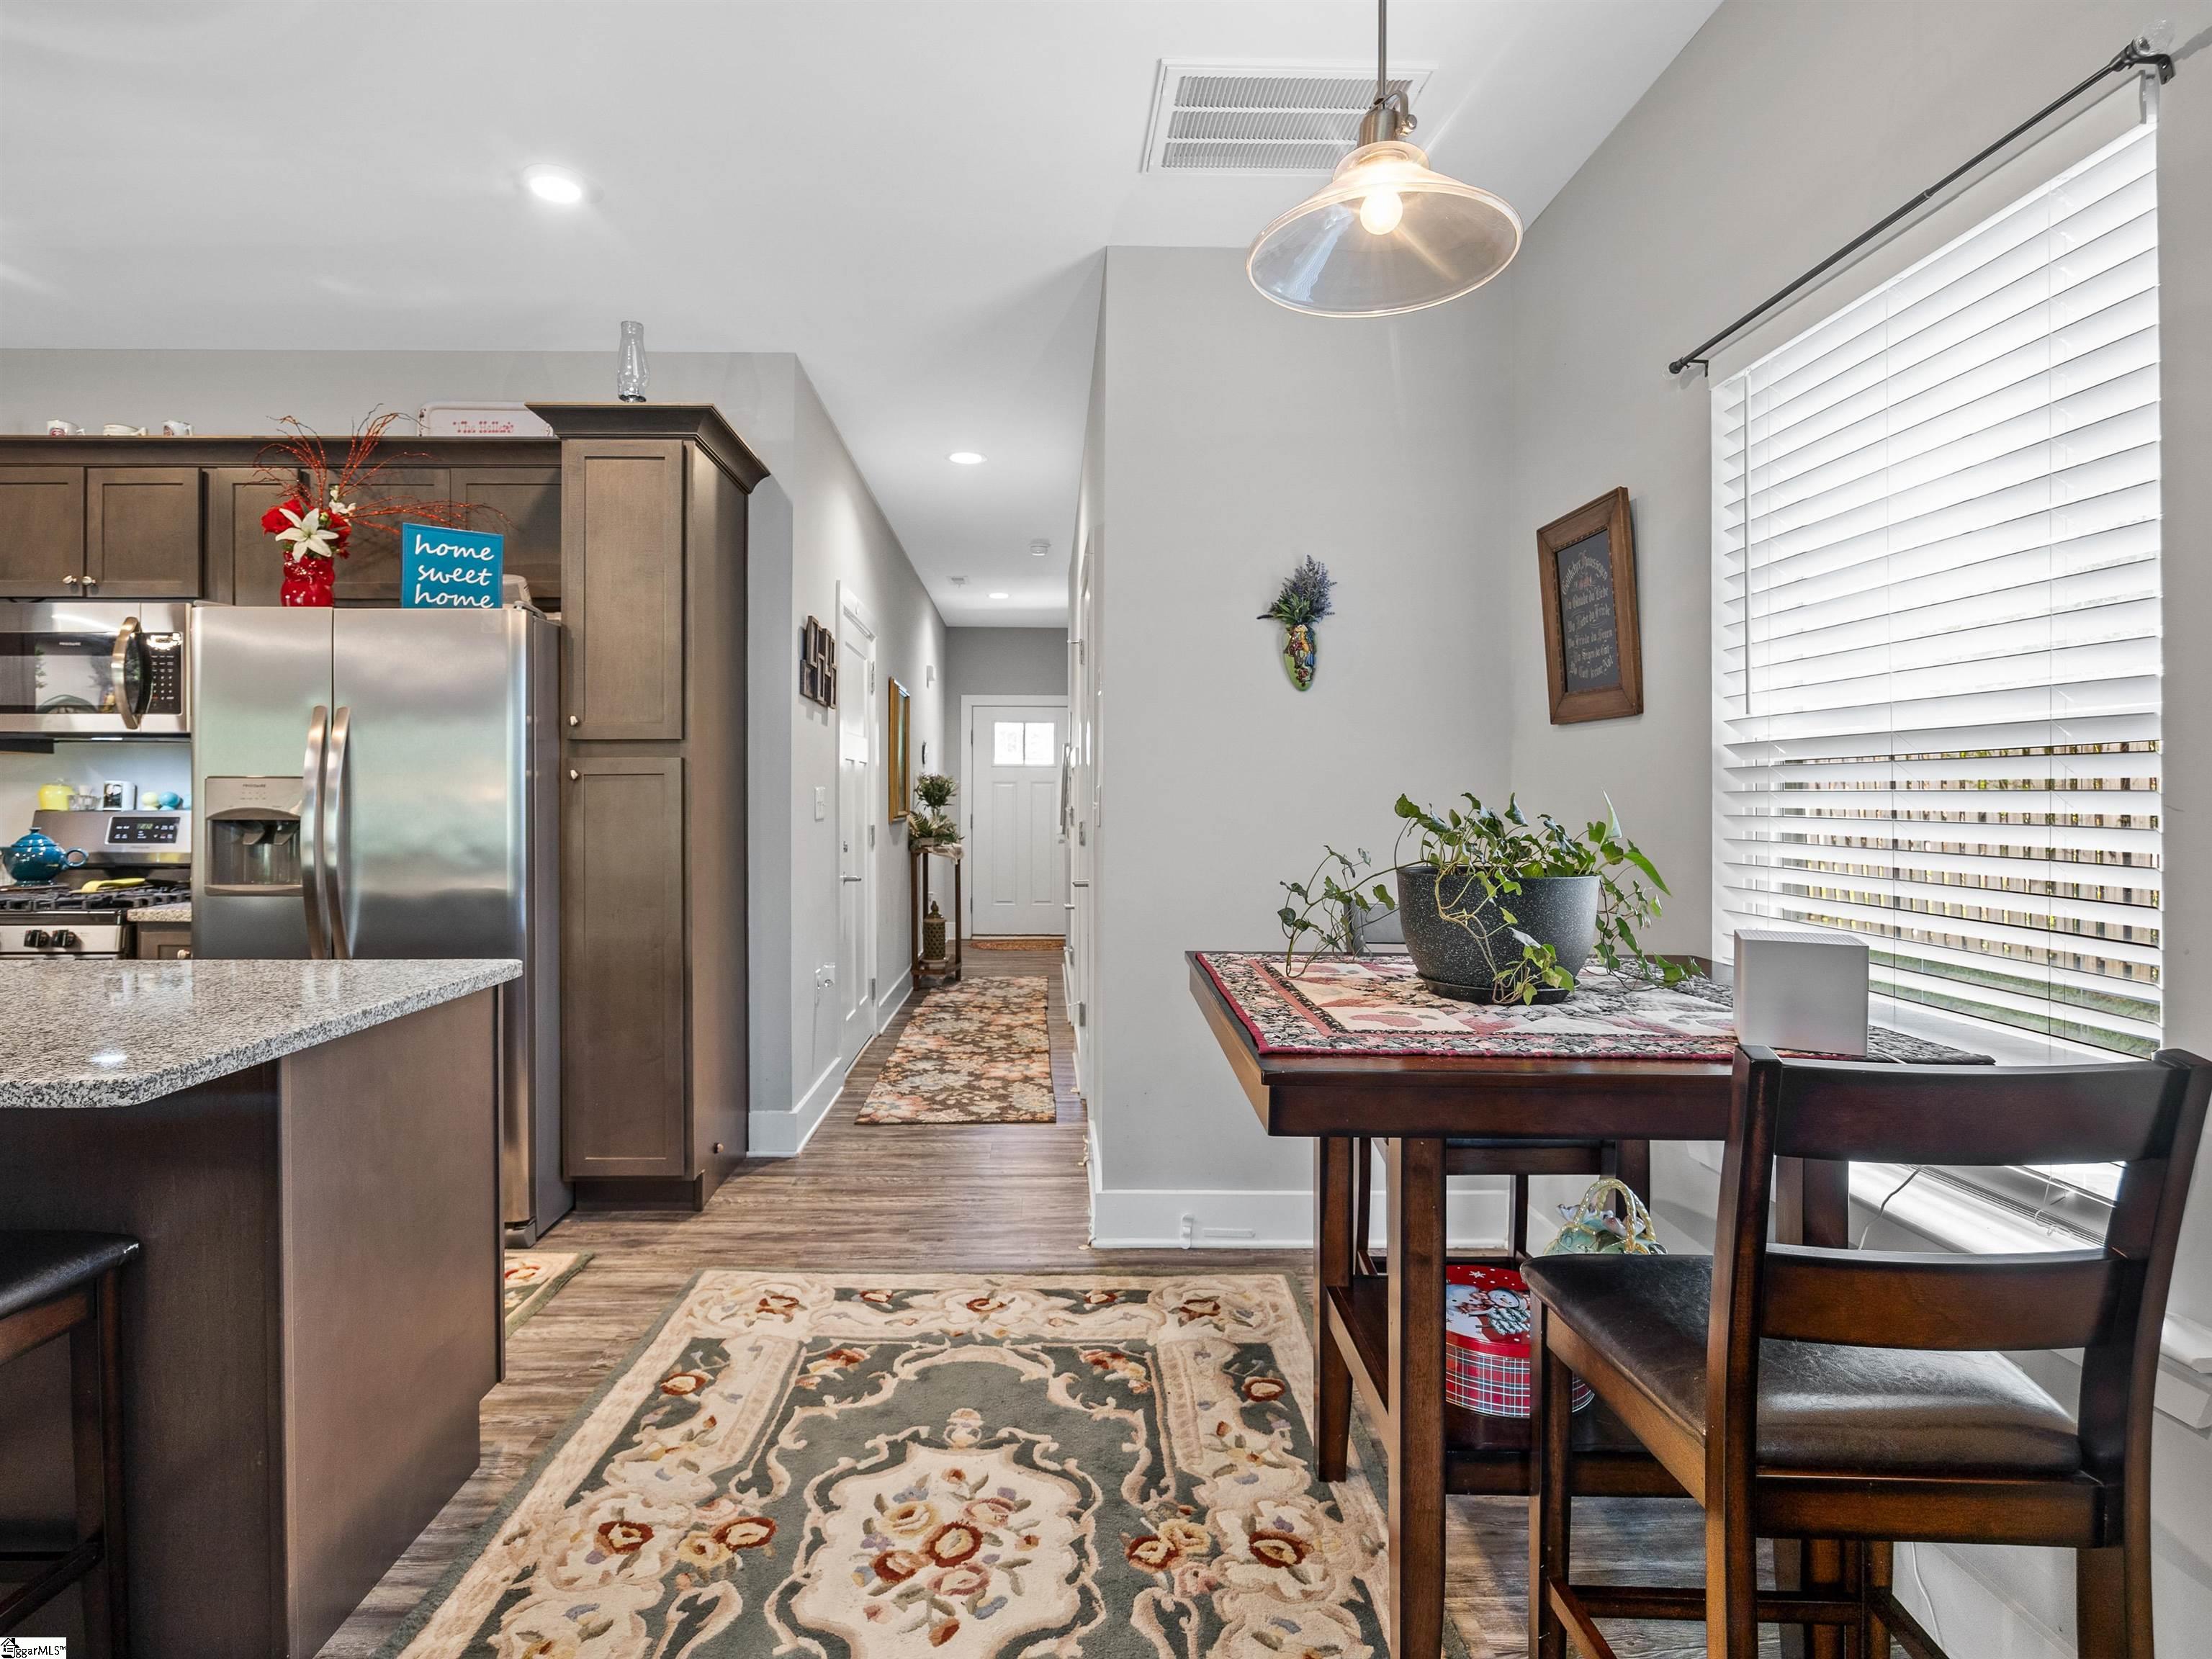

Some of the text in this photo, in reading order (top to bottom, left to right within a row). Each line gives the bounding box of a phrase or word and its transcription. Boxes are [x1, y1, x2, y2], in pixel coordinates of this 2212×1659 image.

[415, 534, 495, 560] home
[418, 565, 493, 585] sweet
[415, 583, 494, 608] home
